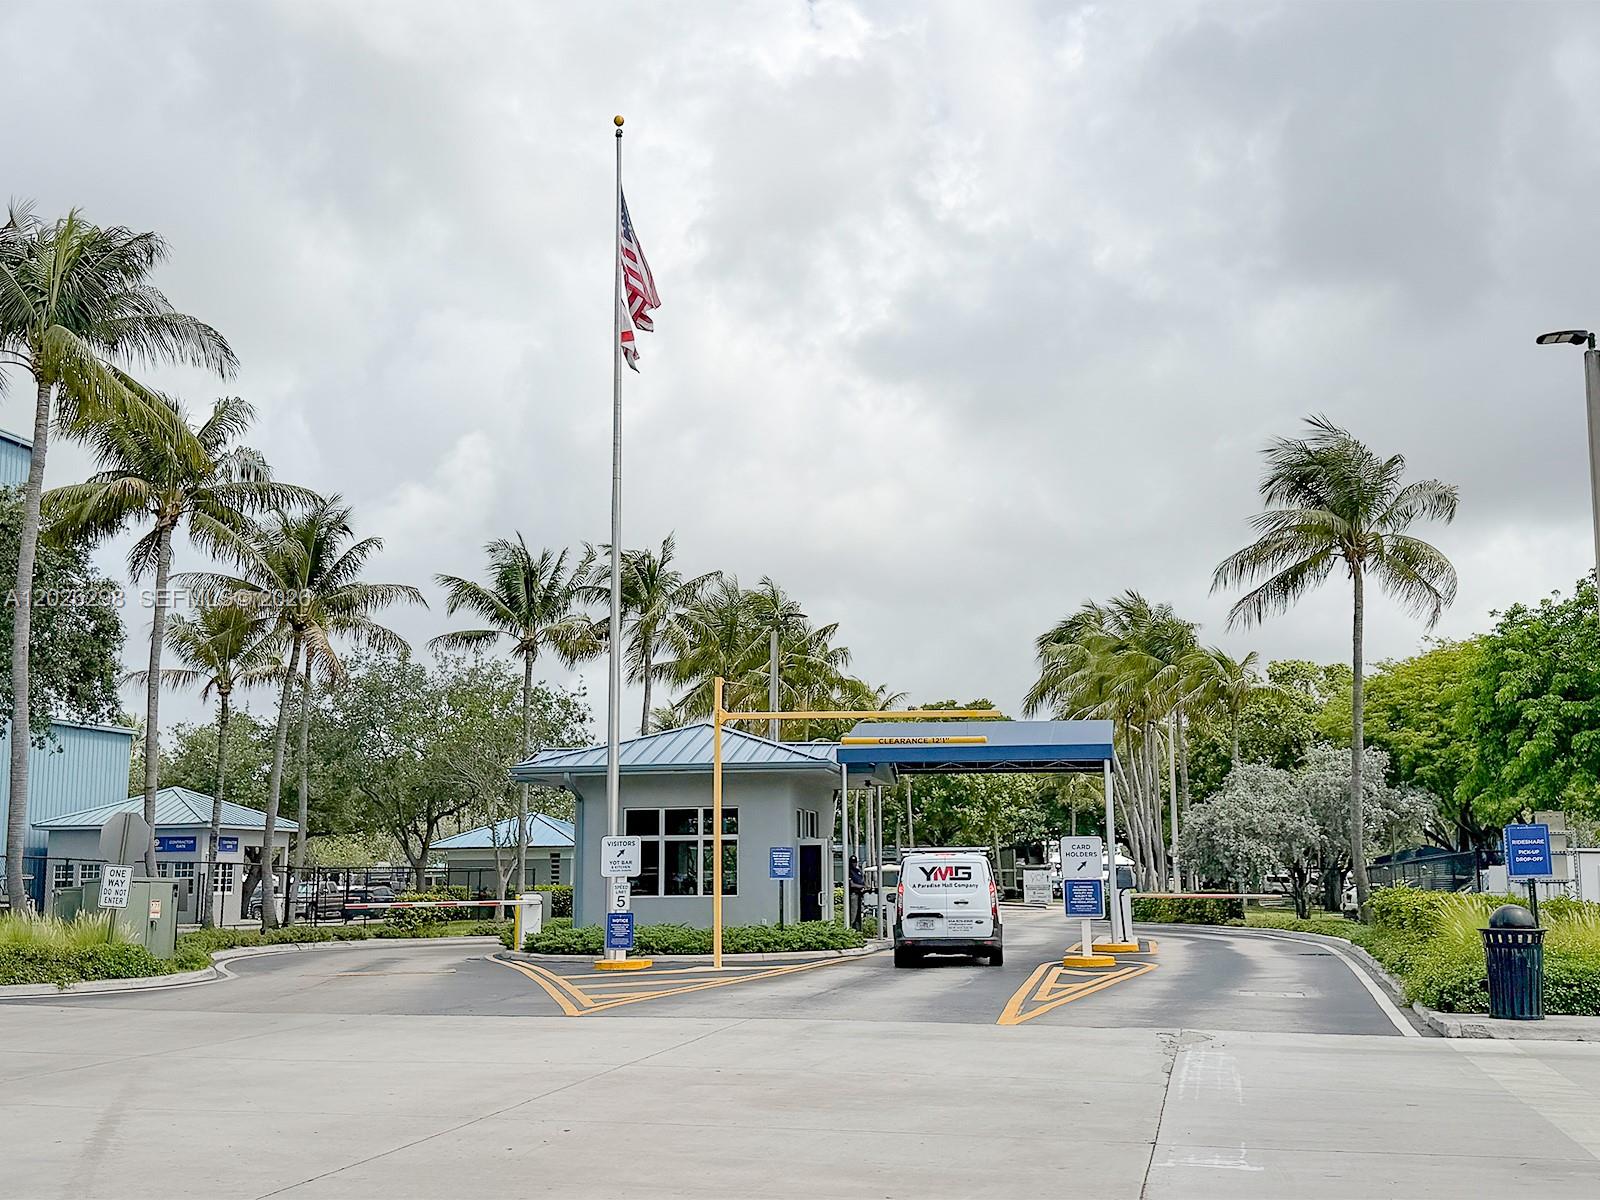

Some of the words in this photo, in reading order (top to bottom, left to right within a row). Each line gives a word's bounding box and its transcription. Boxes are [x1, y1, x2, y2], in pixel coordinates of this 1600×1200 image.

[878, 737, 929, 745] CLEARANCE
[109, 869, 127, 878] ONE
[918, 866, 972, 881] YMG
[108, 879, 126, 887] WAY
[103, 888, 113, 896] DO
[103, 896, 123, 905] ENTER
[616, 895, 626, 908] 5
